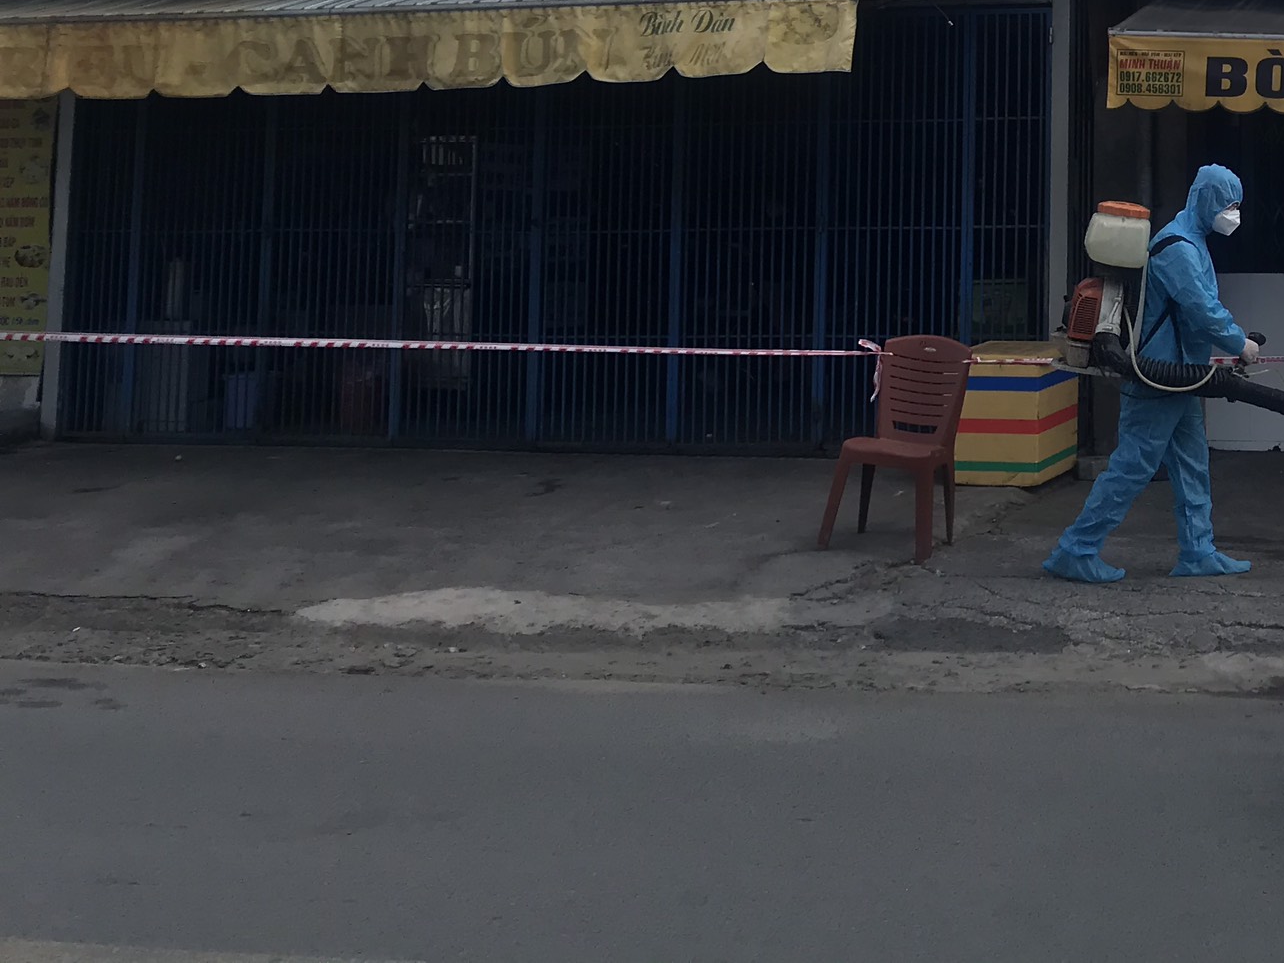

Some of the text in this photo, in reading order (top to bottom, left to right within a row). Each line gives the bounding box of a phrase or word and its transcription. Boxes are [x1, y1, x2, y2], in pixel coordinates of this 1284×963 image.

[639, 9, 684, 37] Bình
[1119, 56, 1182, 72] MINH THUẬN
